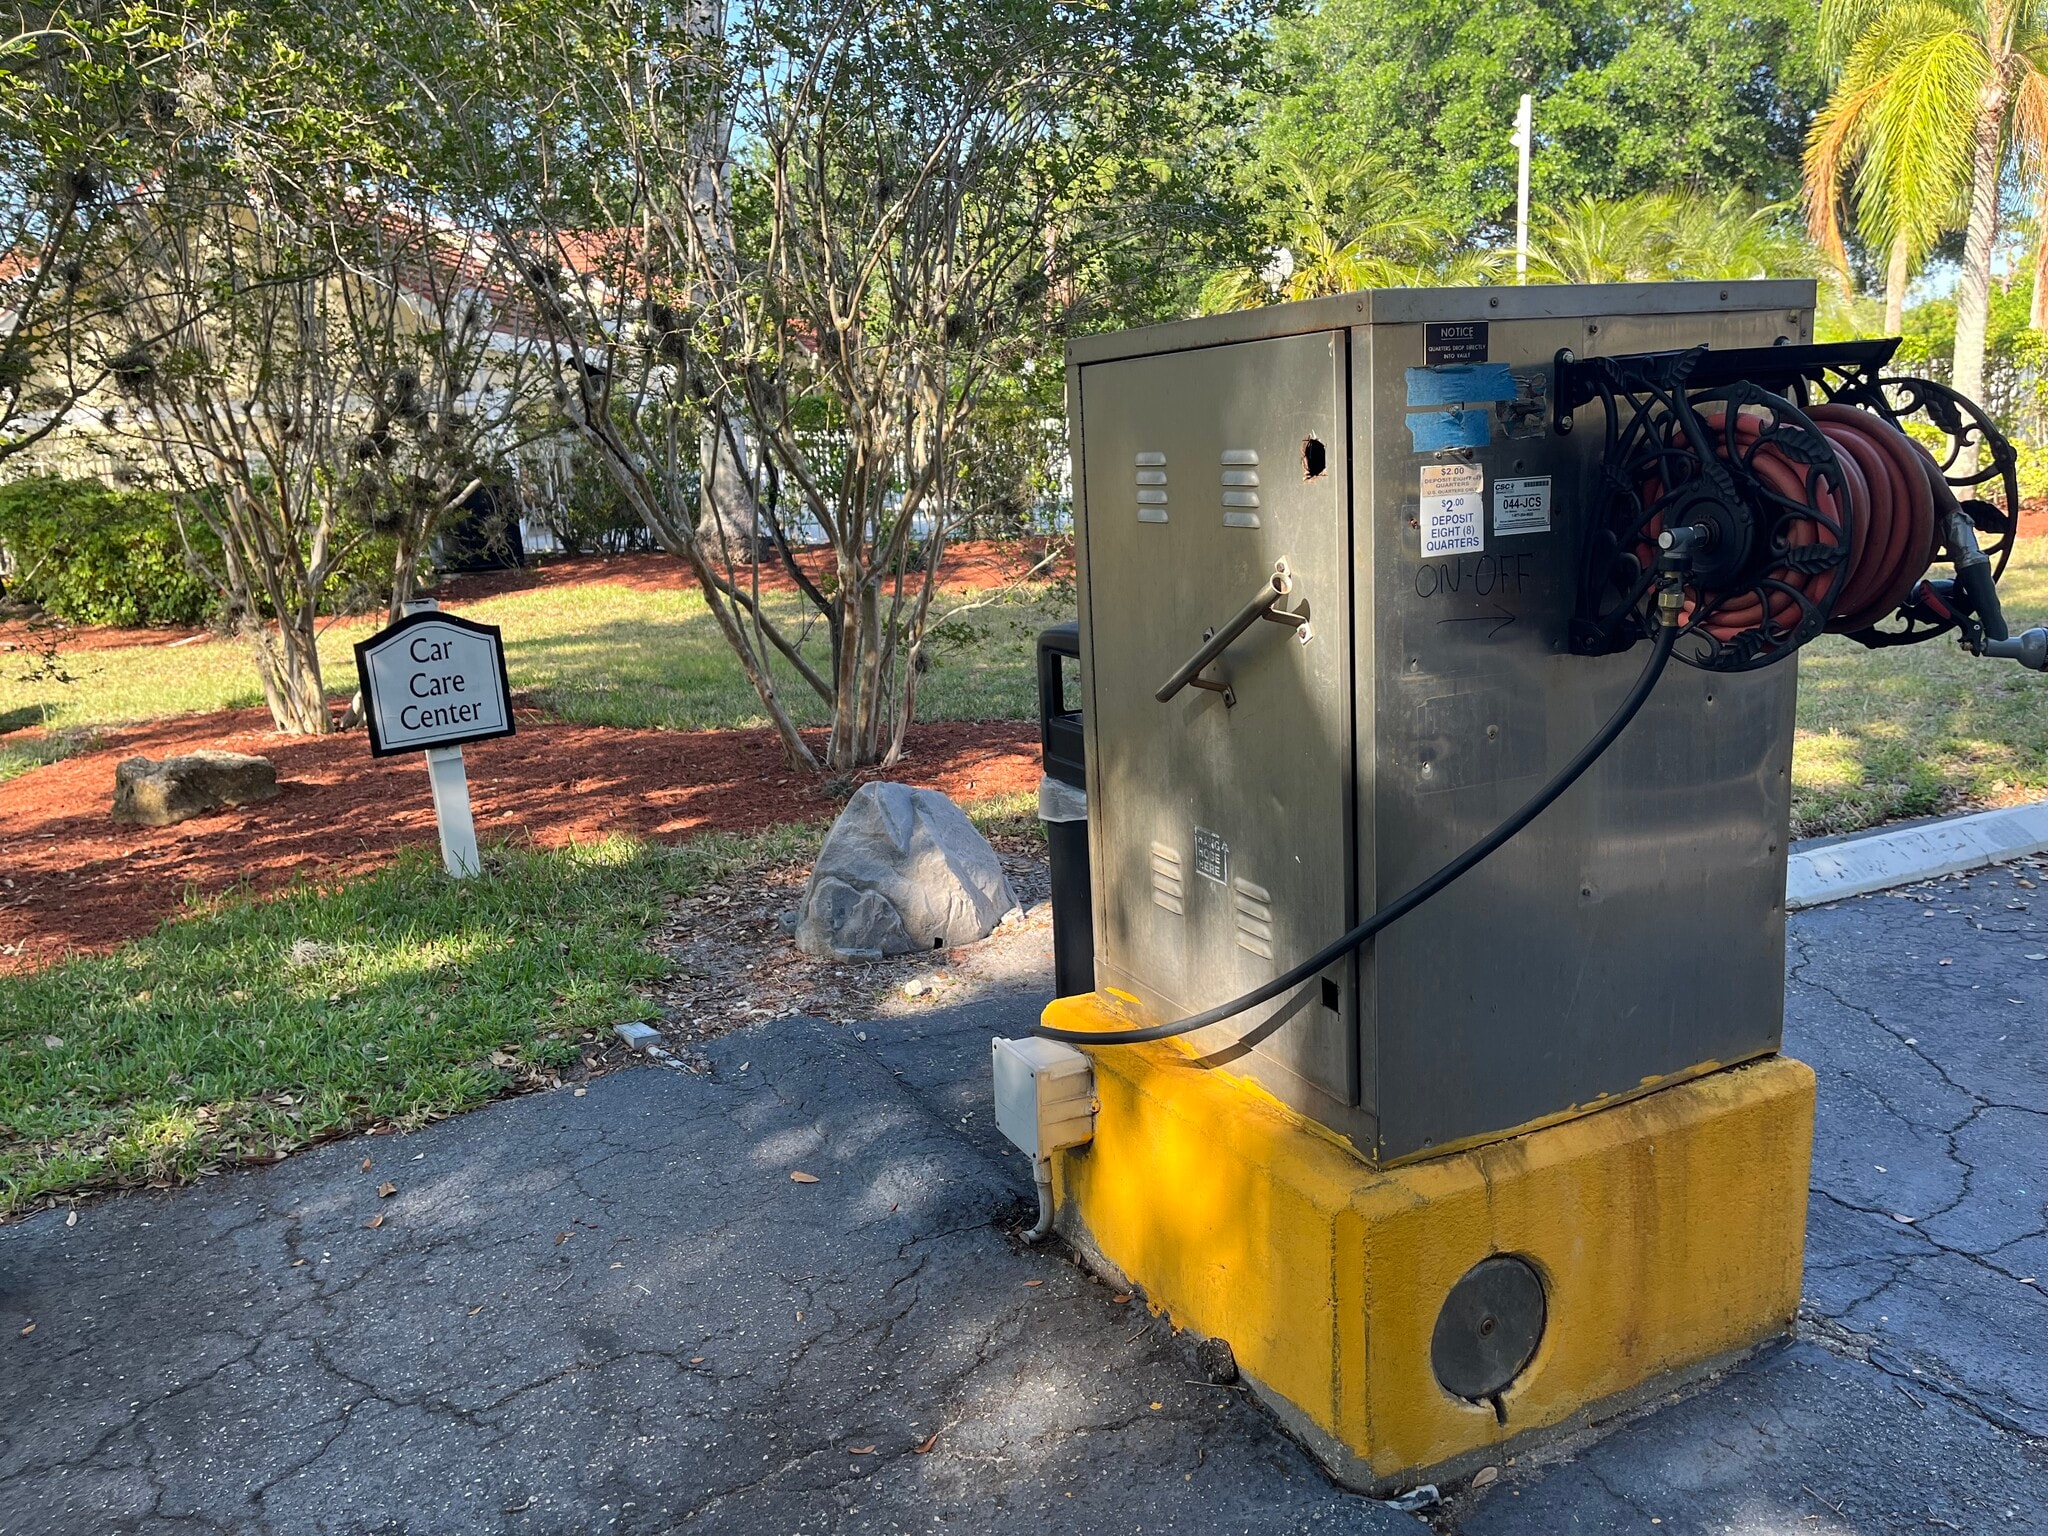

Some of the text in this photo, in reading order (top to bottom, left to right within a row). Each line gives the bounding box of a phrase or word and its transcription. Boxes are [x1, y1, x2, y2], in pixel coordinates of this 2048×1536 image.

[1441, 326, 1474, 338] NOTICE
[1441, 467, 1464, 476] $2.00
[1424, 476, 1451, 484] DEPOSIT
[1503, 496, 1542, 510] 044-JCS
[1432, 513, 1474, 526] DEPOSIT
[1431, 525, 1475, 539] EIGHT (8)
[1426, 536, 1480, 551] QUARTERS
[410, 638, 452, 663] Car
[409, 672, 465, 698] Care
[401, 702, 482, 730] Center
